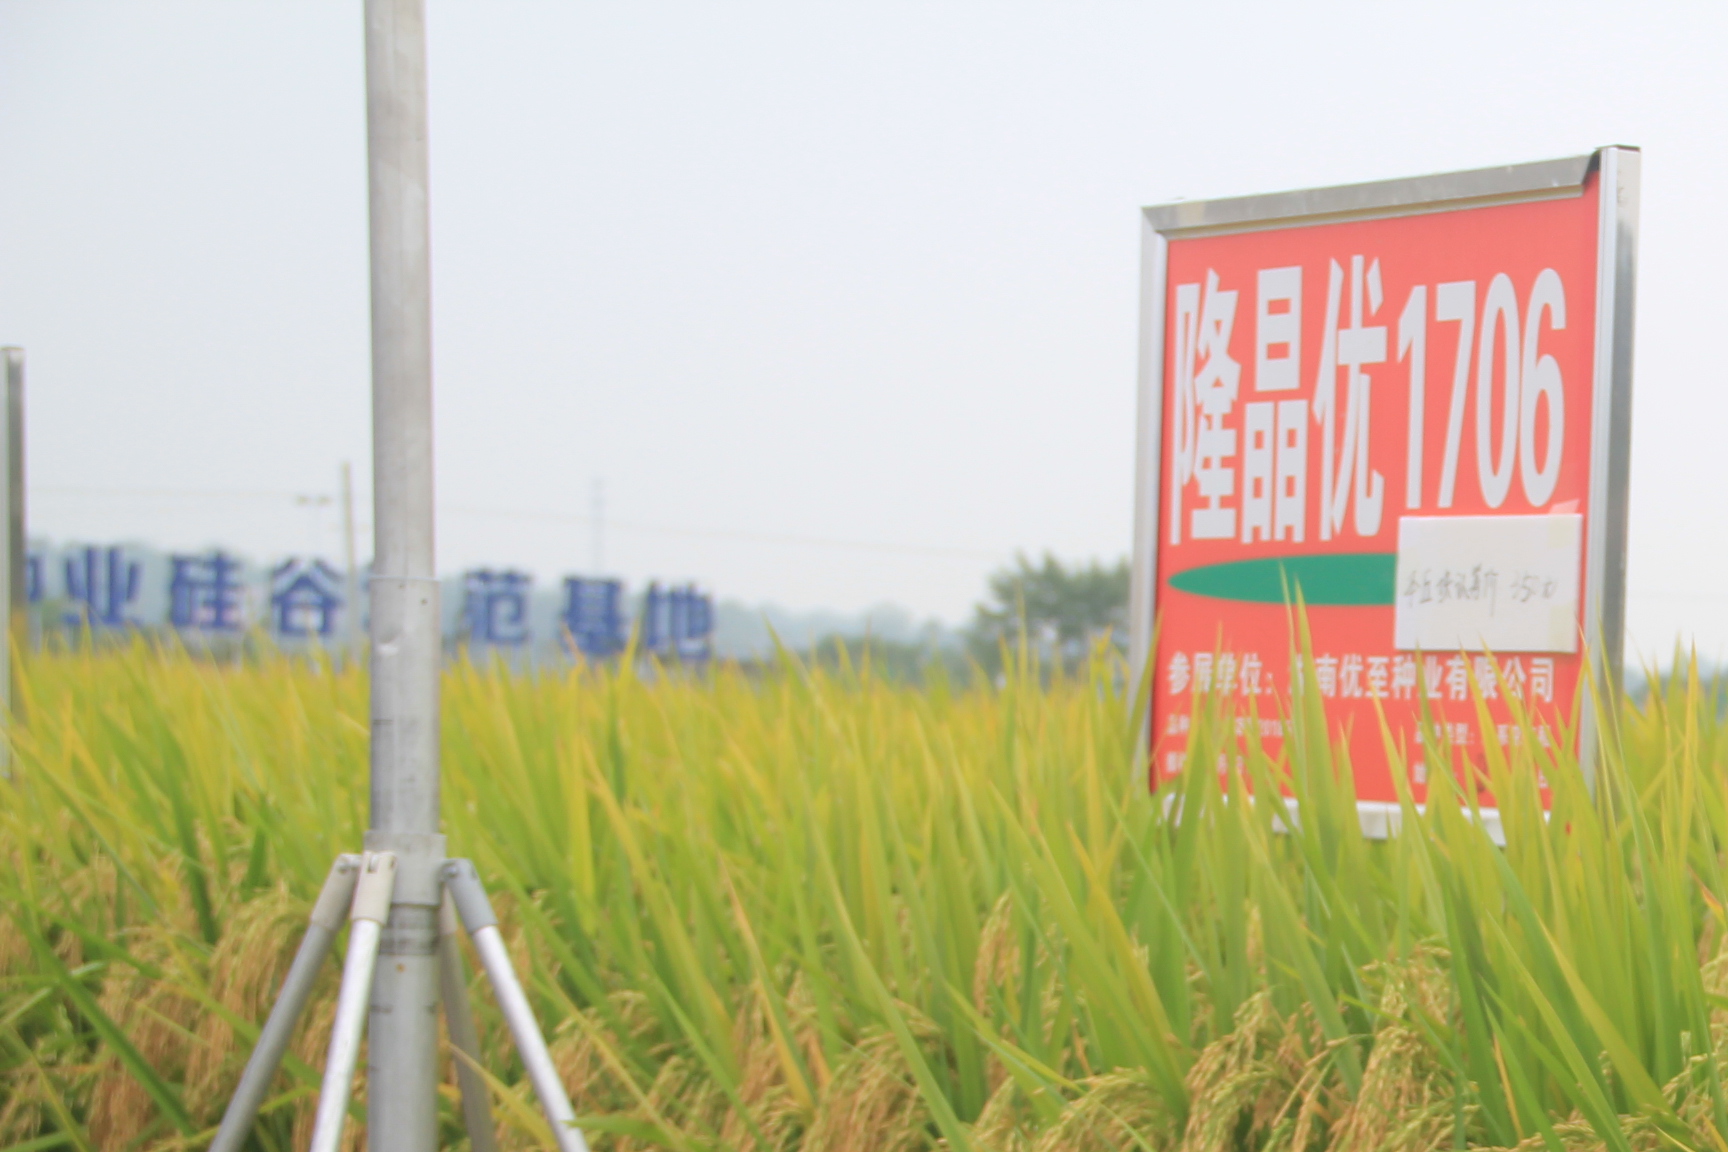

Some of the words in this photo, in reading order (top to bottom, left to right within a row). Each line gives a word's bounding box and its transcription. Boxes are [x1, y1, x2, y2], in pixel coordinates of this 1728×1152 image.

[1169, 254, 1567, 546] 隆晶优1706
[28, 546, 714, 658] 业硅谷范基地
